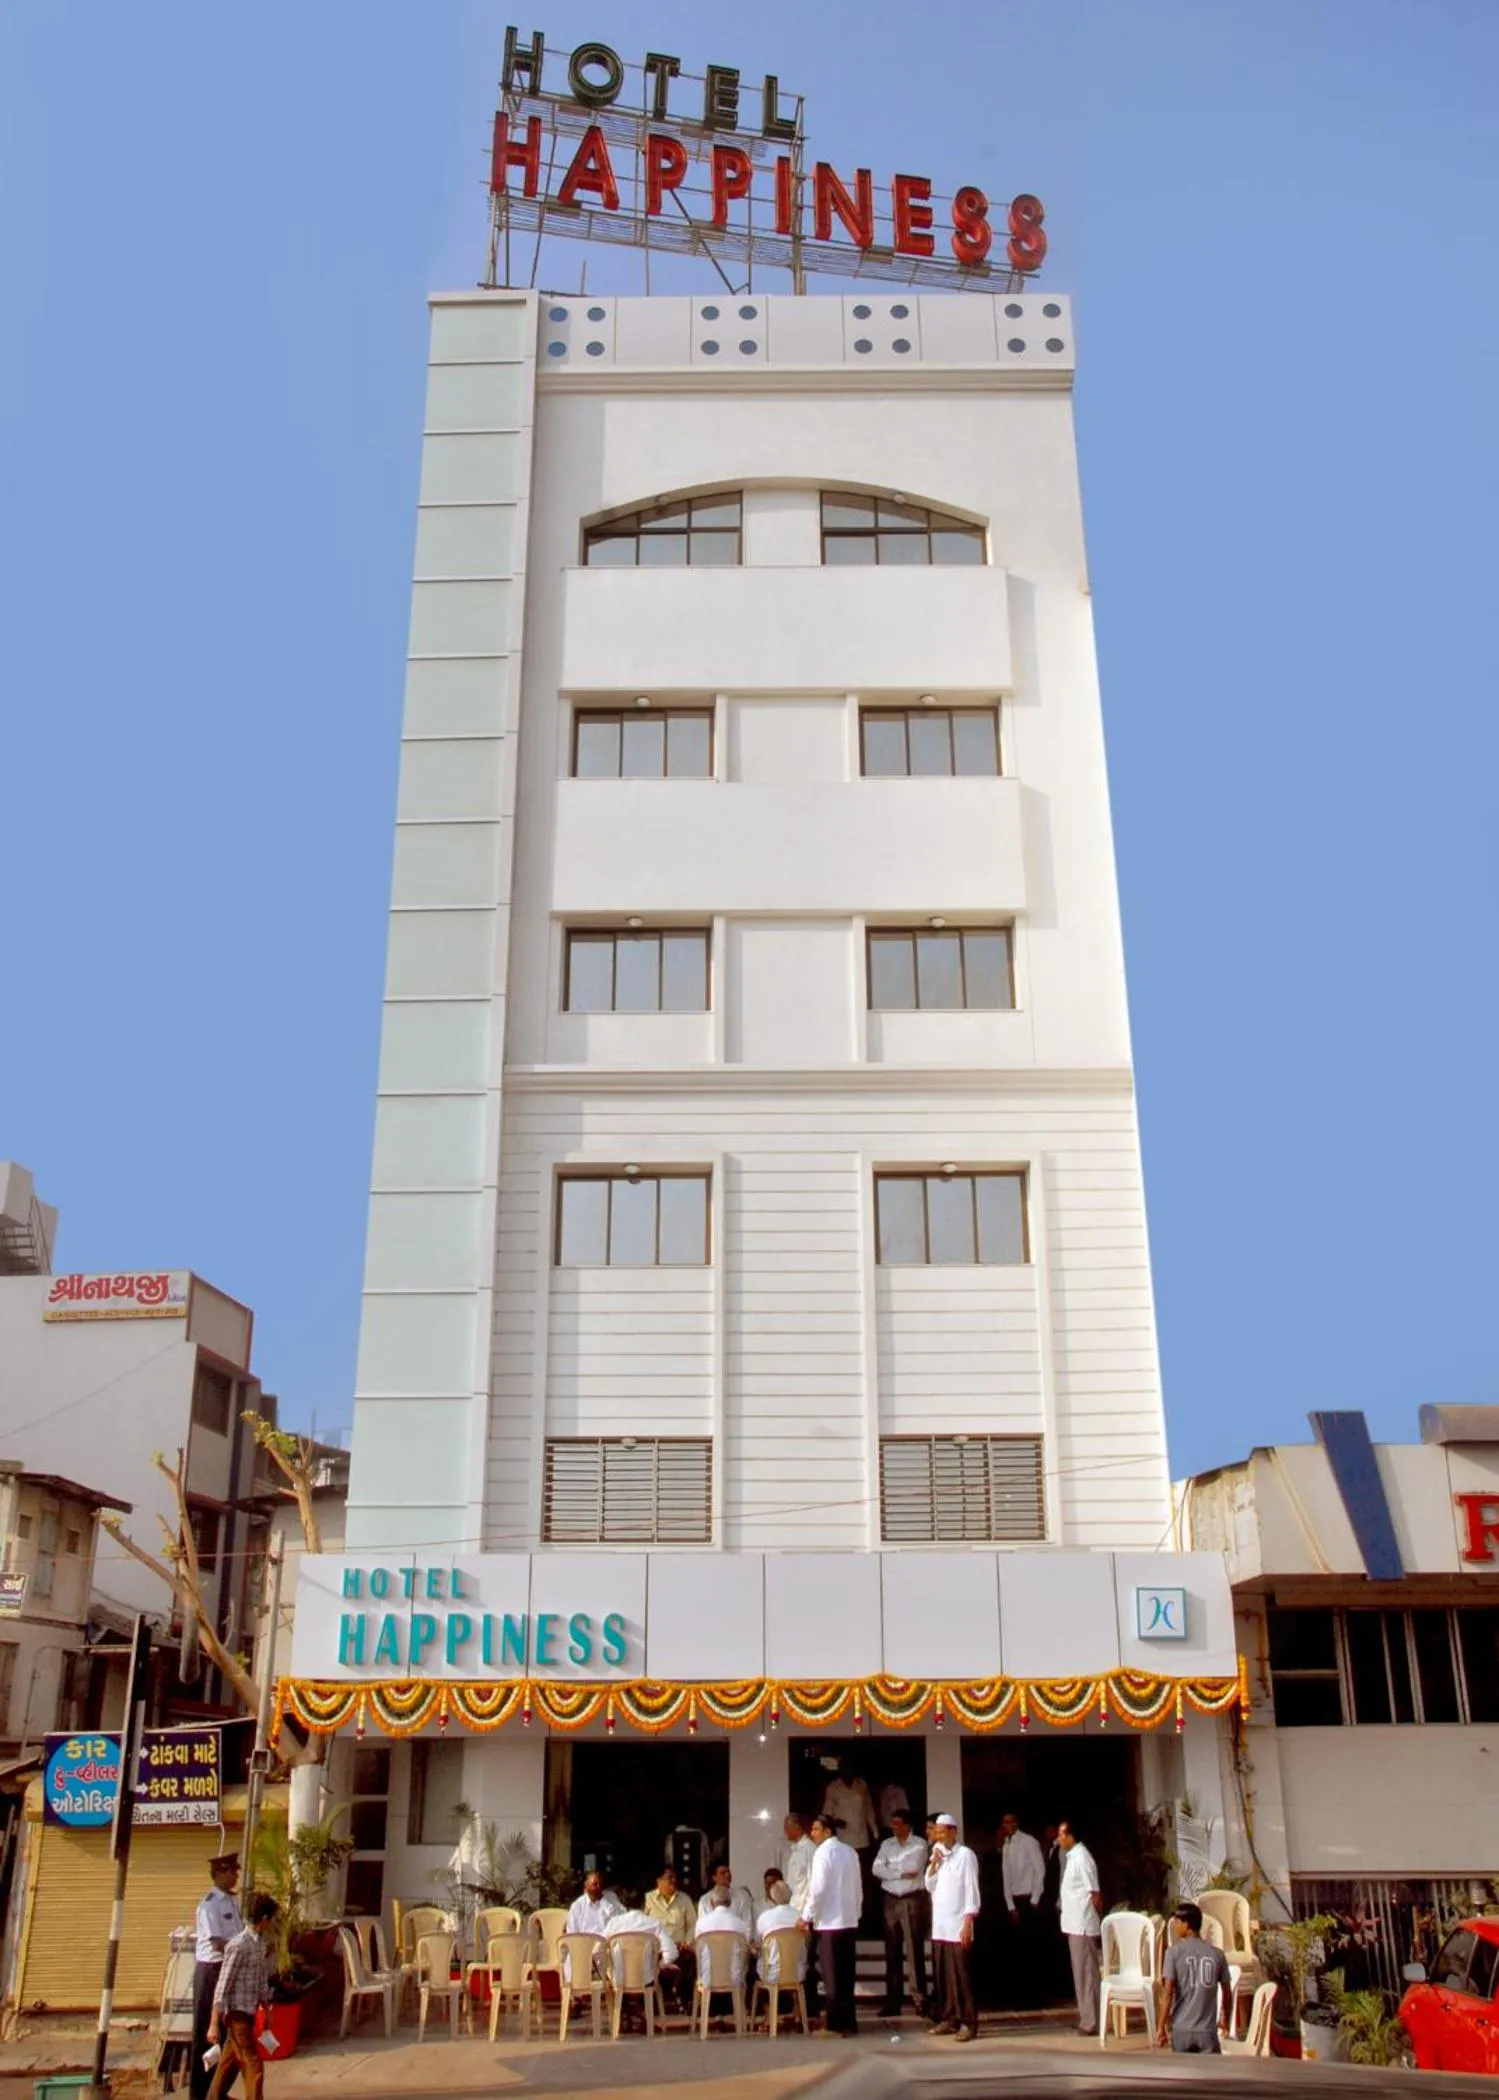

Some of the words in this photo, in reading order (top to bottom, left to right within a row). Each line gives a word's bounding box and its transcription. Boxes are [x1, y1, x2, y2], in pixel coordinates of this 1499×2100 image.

[503, 26, 797, 138] HOTEL
[490, 111, 1046, 270] HAPPINESS
[49, 1273, 170, 1305] શ્રીનાથજી
[341, 1567, 468, 1599] HOTEL
[338, 1612, 627, 1666] HAPPINESS
[65, 1740, 107, 1759] કાર
[194, 1735, 217, 1764] માટે
[150, 1778, 178, 1798] કવર
[183, 1768, 218, 1797] મળશે
[1186, 1956, 1216, 1988] 10
